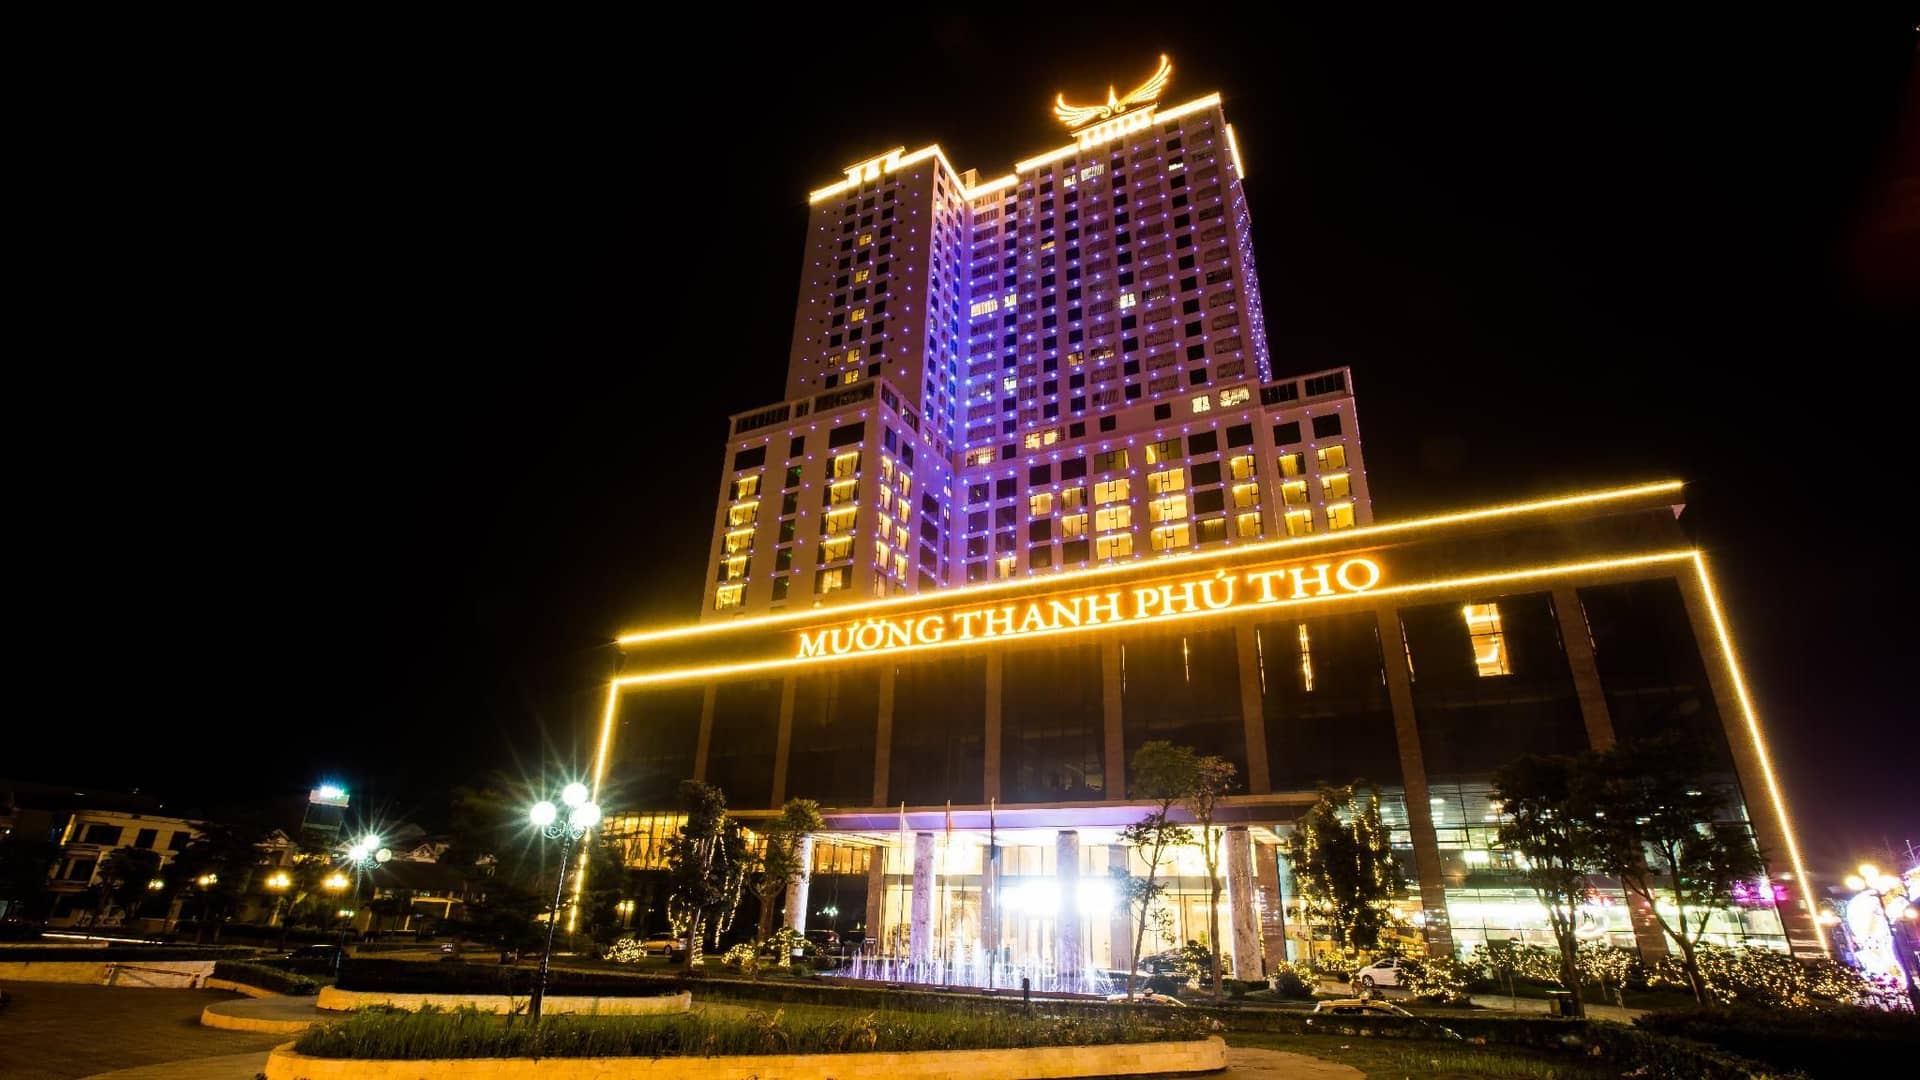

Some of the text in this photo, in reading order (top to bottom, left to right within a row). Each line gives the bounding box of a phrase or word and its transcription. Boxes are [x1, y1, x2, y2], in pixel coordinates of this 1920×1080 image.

[797, 617, 944, 658] MƯỜNG
[953, 592, 1123, 640] THANH
[1133, 569, 1237, 619] PHÚ
